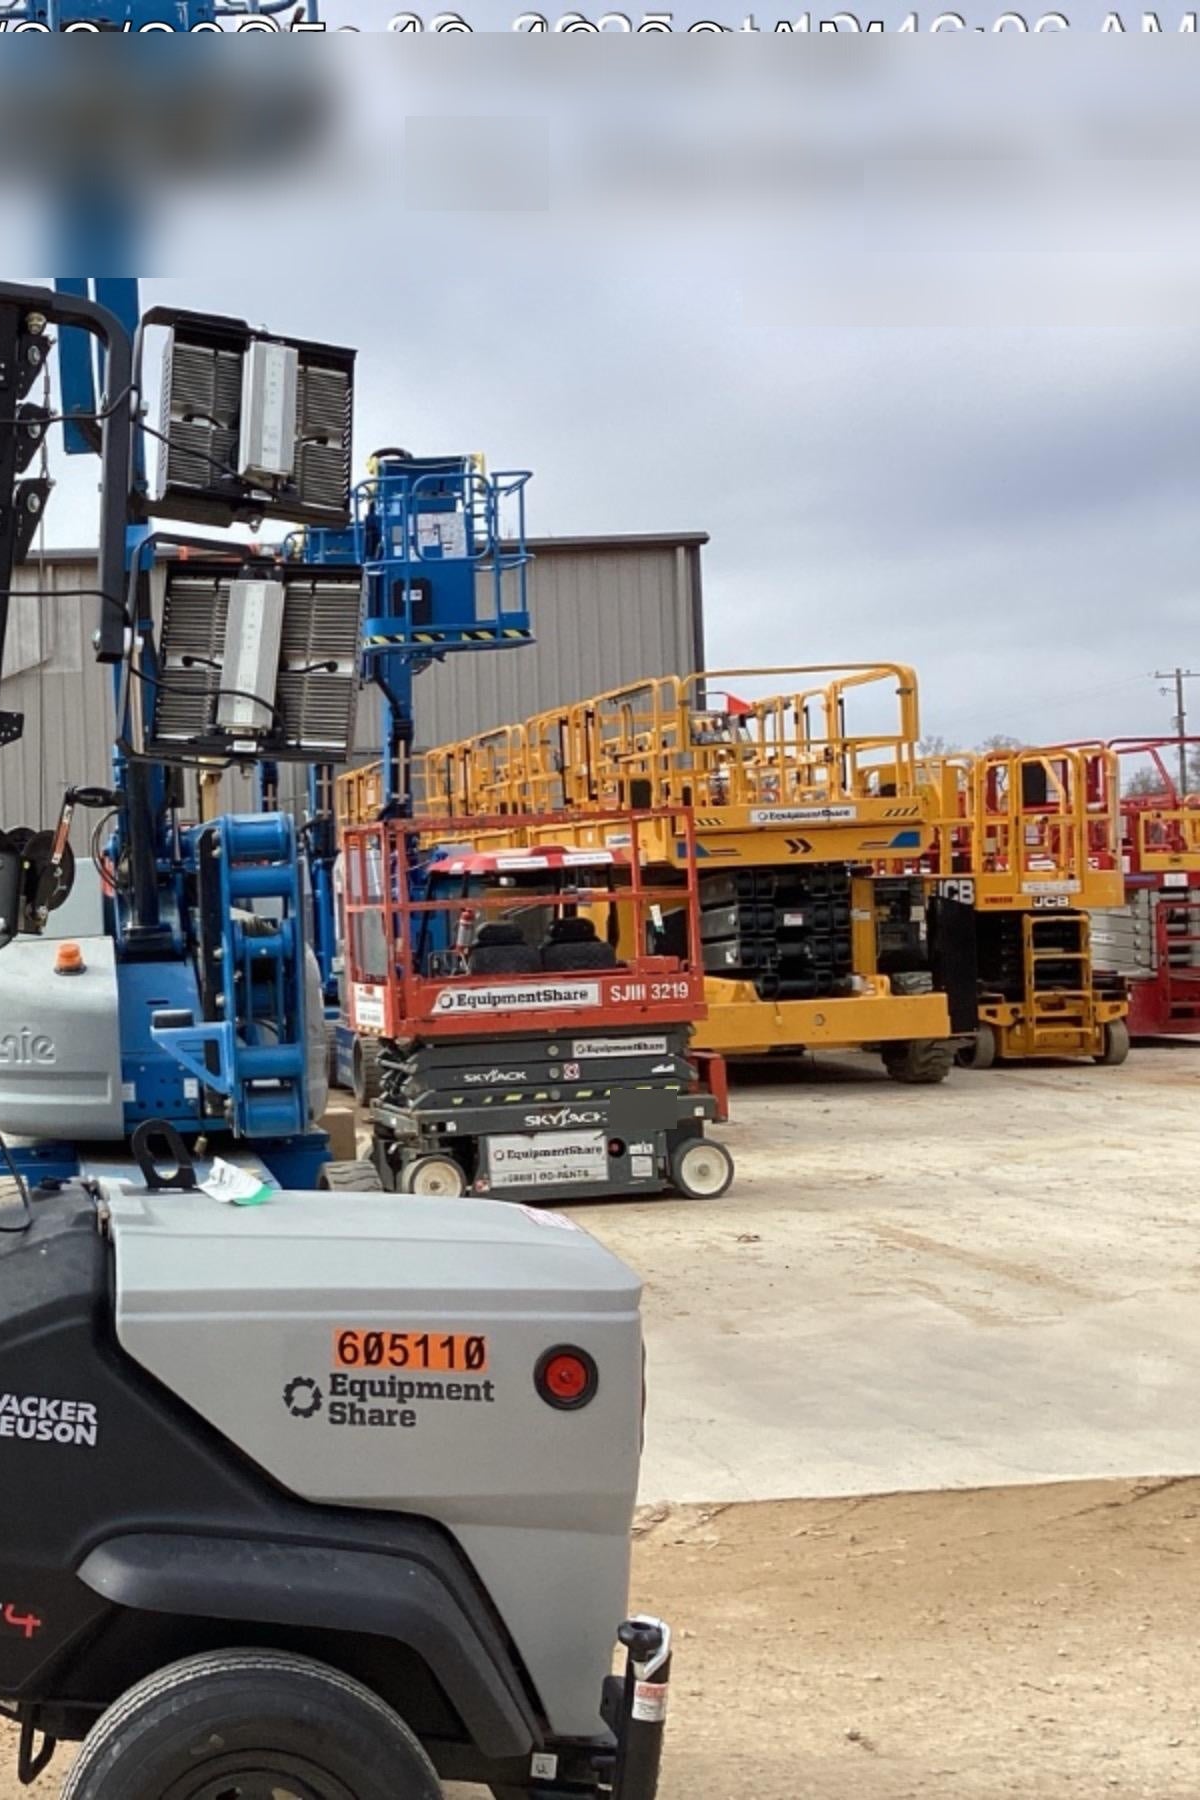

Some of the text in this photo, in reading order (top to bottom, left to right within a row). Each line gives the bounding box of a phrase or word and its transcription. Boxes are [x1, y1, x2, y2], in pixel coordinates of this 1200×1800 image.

[1033, 896, 1069, 907] JCB
[456, 988, 589, 1008] EquipmentShare
[651, 982, 689, 1000] 3219
[463, 1069, 528, 1083] SKYJACK
[337, 1331, 486, 1370] 605110
[329, 1373, 496, 1404] Equipment
[328, 1402, 417, 1428] Share
